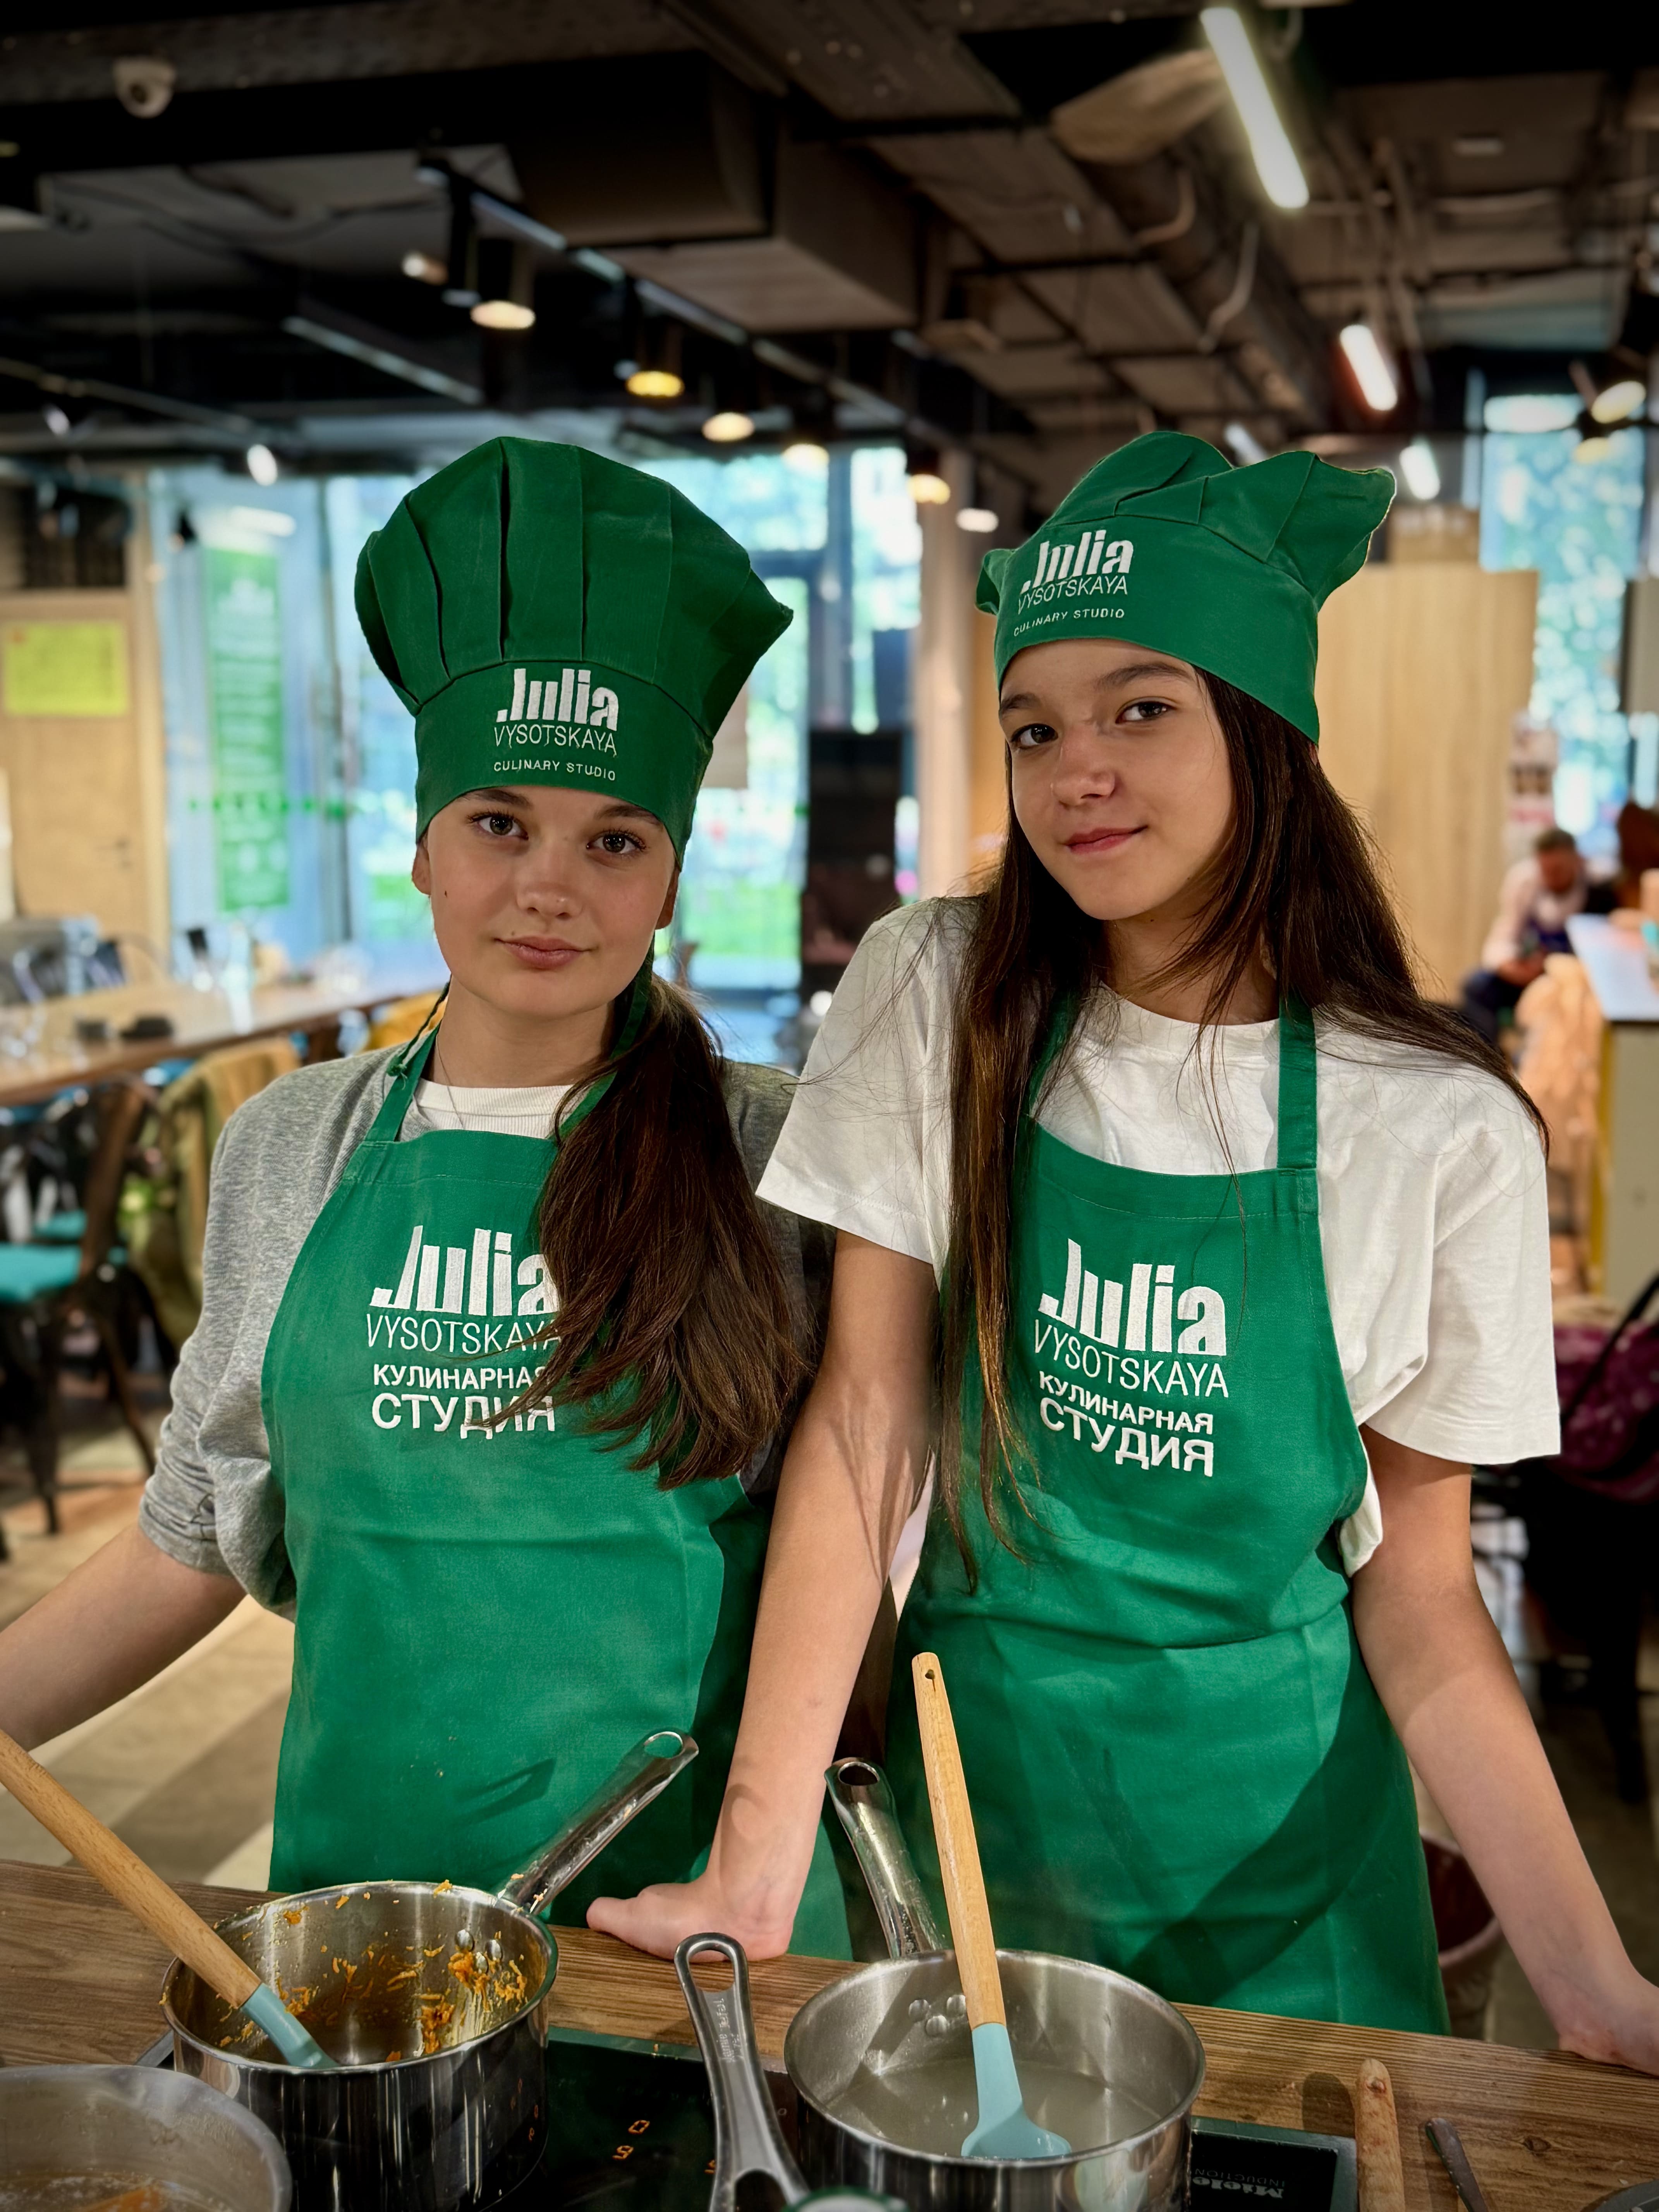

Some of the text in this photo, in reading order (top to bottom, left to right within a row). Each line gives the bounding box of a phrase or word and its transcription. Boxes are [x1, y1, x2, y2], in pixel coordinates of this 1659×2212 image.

[1020, 529, 1134, 594] Julia
[1018, 575, 1128, 615] VYSOTSKAYA
[1013, 608, 1125, 637] CULINARY STUDIO
[496, 668, 619, 732] Julia
[494, 723, 617, 757] VYSOTSKAYA
[493, 759, 616, 781] CULINARY STUDIO
[369, 1225, 561, 1317] Julia
[1038, 1238, 1227, 1356] Julia
[373, 1364, 551, 1390] КУЛИНАРНА
[1035, 1319, 1229, 1398] VYSOTSKAYA
[1039, 1370, 1213, 1435] КУЛИНАРНАЯ
[1040, 1397, 1214, 1477] СТУДИЯ
[1192, 2176, 1284, 2199] Miele
[1195, 2168, 1285, 2187] INDUCTION
